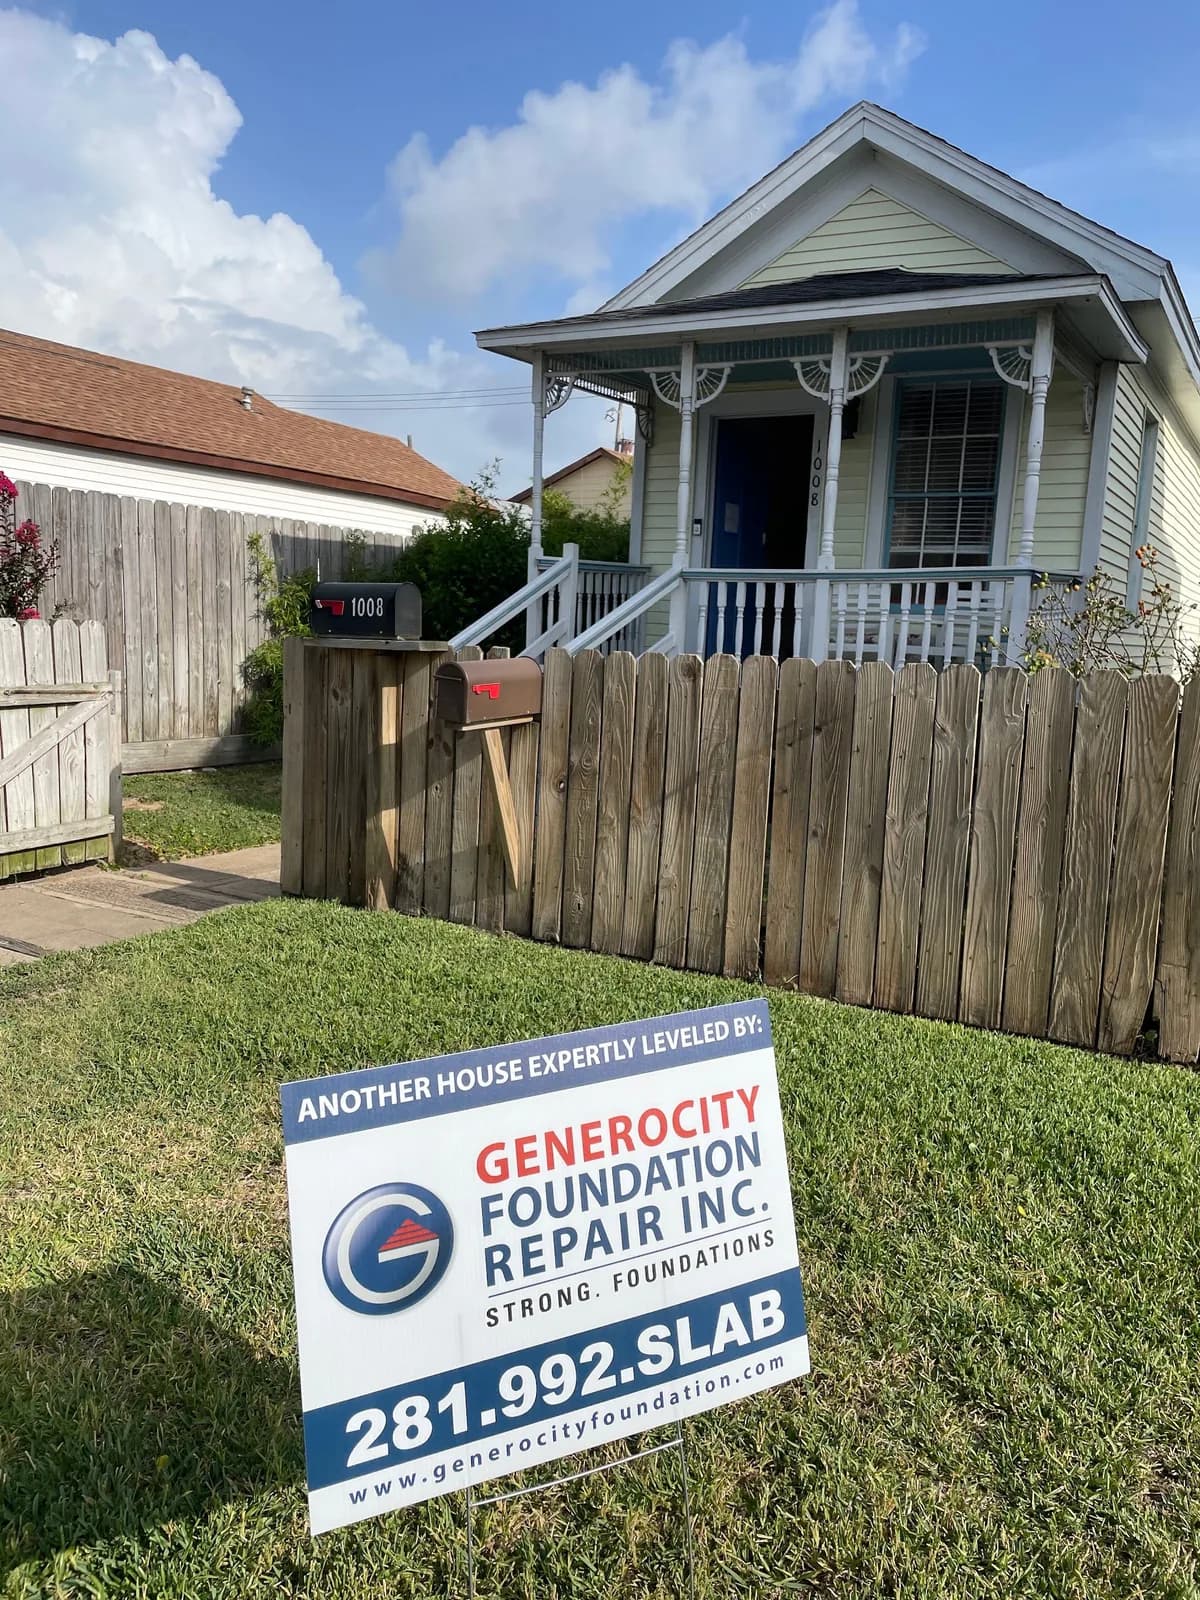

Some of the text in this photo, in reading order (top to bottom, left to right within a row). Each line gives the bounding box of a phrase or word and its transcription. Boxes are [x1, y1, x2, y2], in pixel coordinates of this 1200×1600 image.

[811, 439, 822, 506] 1008
[351, 597, 384, 617] 1008
[298, 1015, 763, 1122] ANOTHER HOUSE EXPERTLY LEVELED BY:
[476, 1085, 759, 1184] GENEROCITY
[481, 1132, 762, 1236] FOUNDATION
[484, 1179, 770, 1286] REPAIR INC.
[487, 1230, 775, 1327] STRONG. FOUNDATIONS
[345, 1289, 785, 1467] 281.992.SLAB
[349, 1354, 784, 1504] www.generocityfoundation.com
